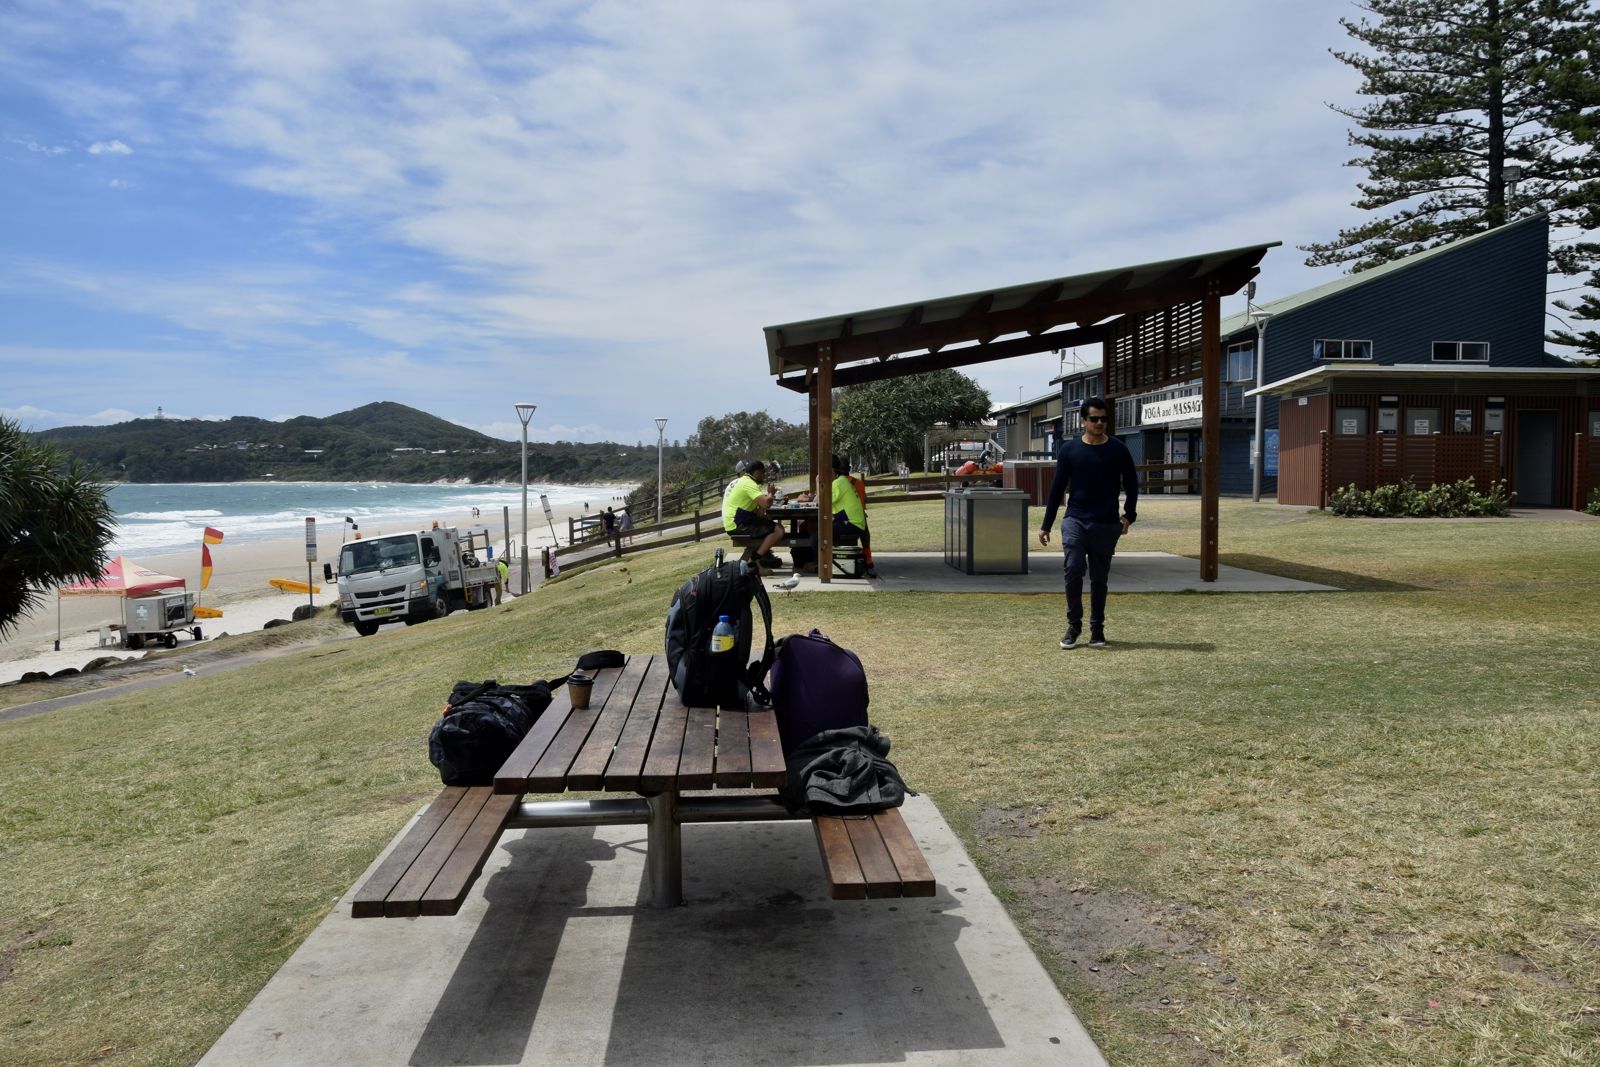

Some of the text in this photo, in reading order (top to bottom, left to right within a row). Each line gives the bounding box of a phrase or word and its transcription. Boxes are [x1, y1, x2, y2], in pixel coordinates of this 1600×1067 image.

[1144, 400, 1203, 419] YOGA and MASSAG
